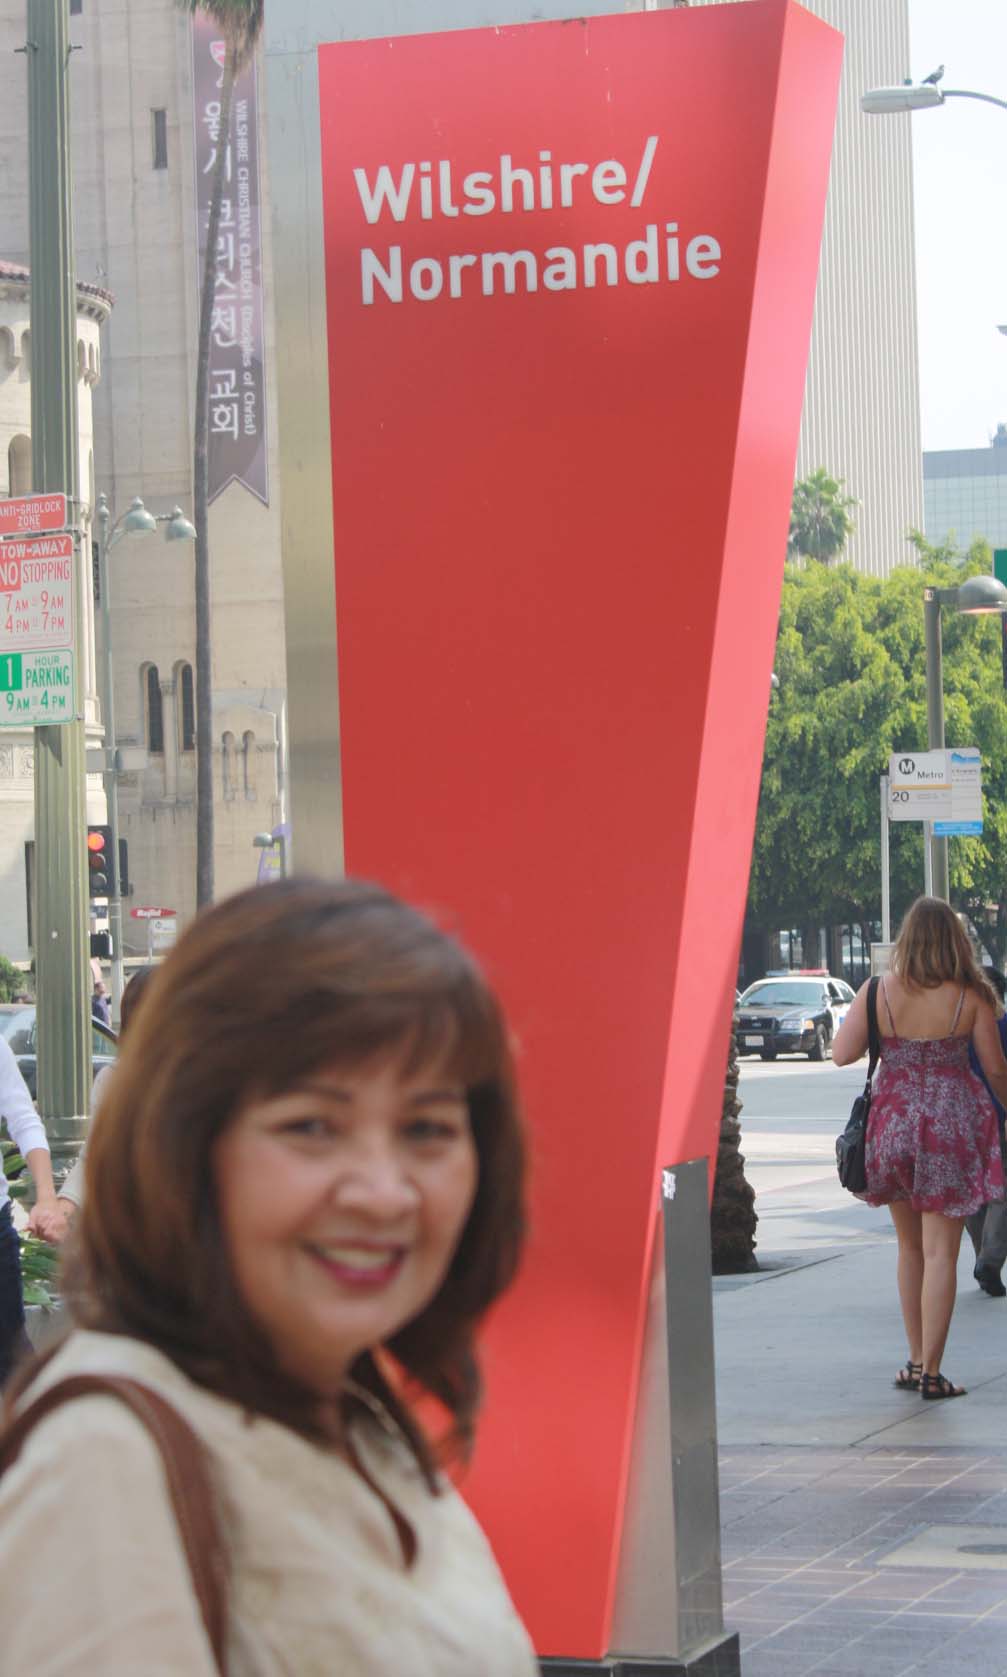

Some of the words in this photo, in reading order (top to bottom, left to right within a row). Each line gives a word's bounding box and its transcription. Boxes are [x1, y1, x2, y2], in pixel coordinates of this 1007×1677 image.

[235, 99, 249, 161] WILSHIRE
[353, 135, 659, 225] Wilshire/
[237, 167, 251, 238] CHRISTIAN
[240, 243, 253, 300] CHURCH
[360, 222, 722, 305] Normandie
[243, 371, 255, 386] of
[210, 369, 239, 440] 교회
[243, 392, 257, 435] Christ)
[0, 499, 62, 517] ANTI-GRIDLOCK
[17, 514, 41, 528] ZONE
[0, 539, 68, 559] TOW-AWAY
[0, 560, 19, 586] NO
[23, 560, 71, 584] STOPPING
[6, 655, 13, 688] 1
[34, 655, 60, 666] HOUR
[25, 665, 70, 688] PARKING
[917, 771, 944, 780] Metro
[892, 791, 910, 802] 20
